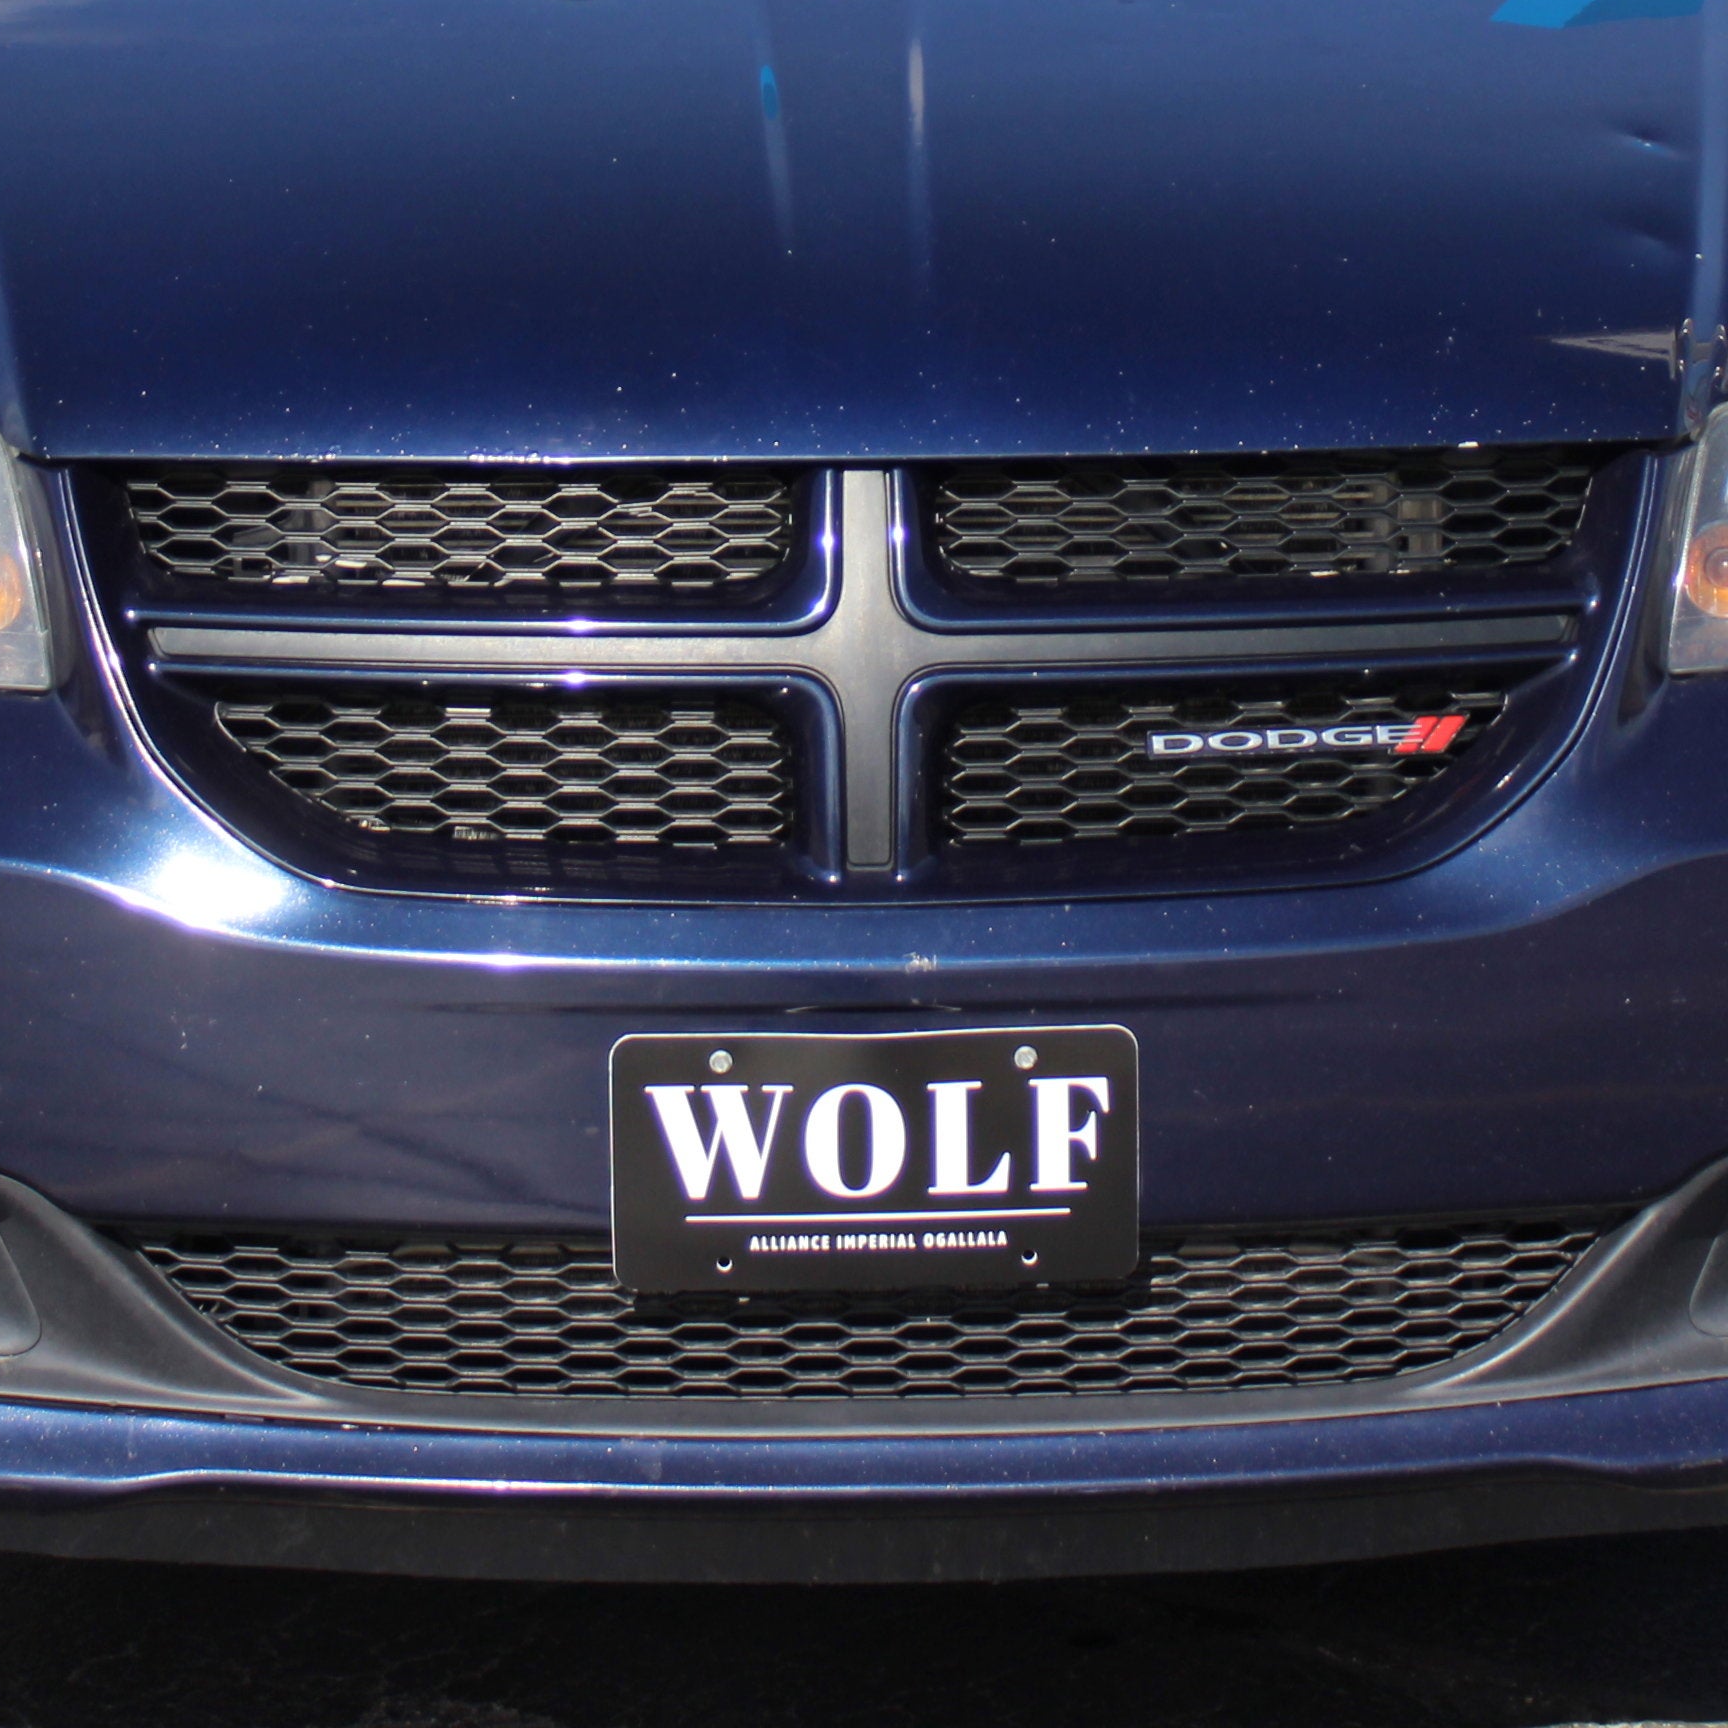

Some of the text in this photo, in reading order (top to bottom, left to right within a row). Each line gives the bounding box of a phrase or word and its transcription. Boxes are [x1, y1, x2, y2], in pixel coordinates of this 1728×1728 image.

[1151, 723, 1423, 754] DODGE
[643, 1076, 1110, 1200] WOLF
[749, 1230, 1008, 1251] ALLIANCE IMPERIAL OGALLALA
